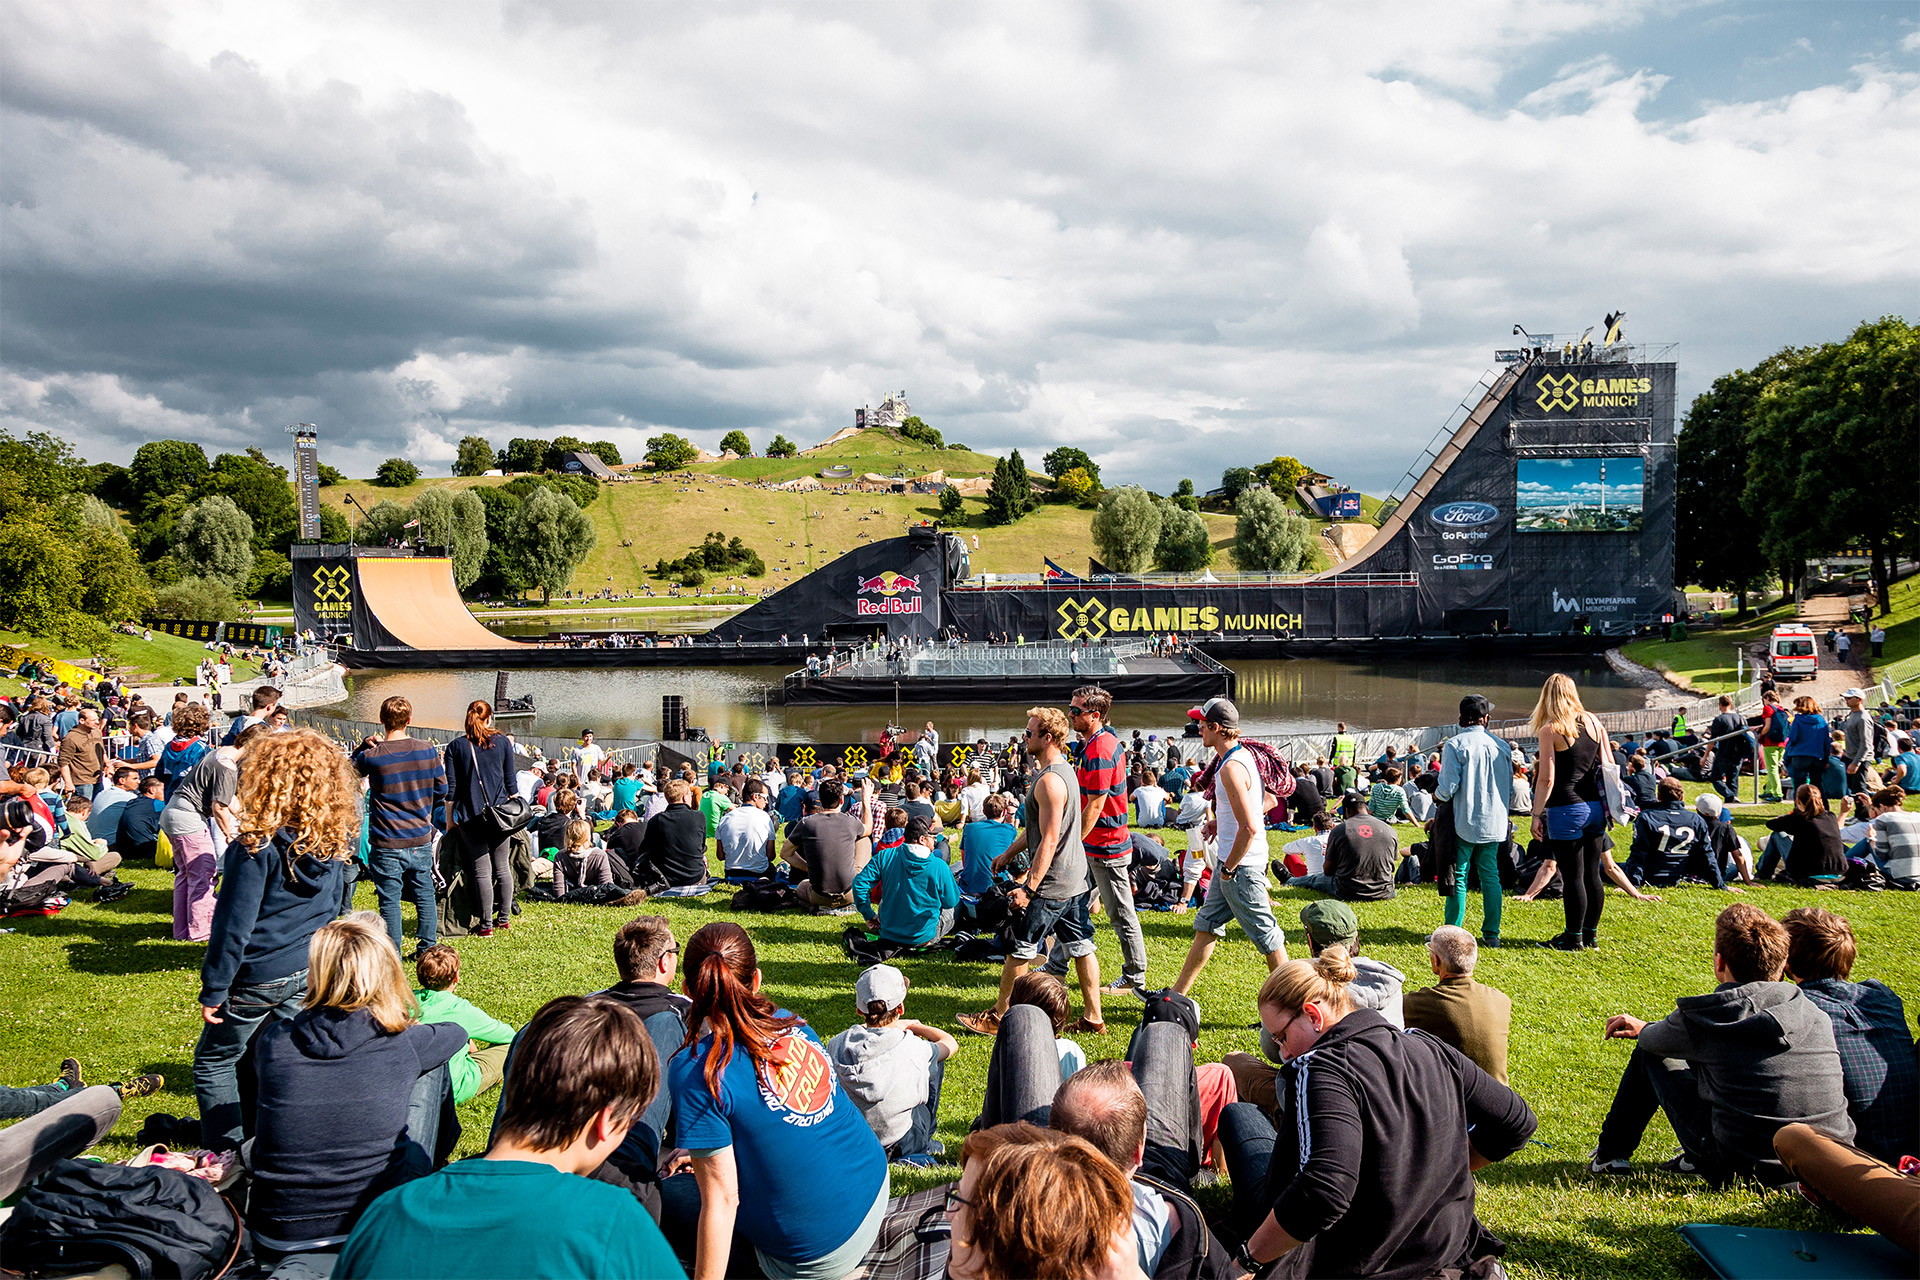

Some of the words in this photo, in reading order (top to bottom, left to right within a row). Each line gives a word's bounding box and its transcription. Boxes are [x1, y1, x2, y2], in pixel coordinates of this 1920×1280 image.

[1581, 377, 1652, 395] GAMES
[1582, 395, 1638, 408] MUNICH
[1443, 505, 1486, 522] Ford
[1442, 531, 1455, 540] Go
[1456, 530, 1488, 539] Further
[1432, 553, 1494, 564] GoPro
[313, 602, 352, 612] GAMES
[857, 596, 890, 615] Red
[890, 595, 922, 615] Bull
[1585, 597, 1637, 605] OLYMPIAPARK
[318, 611, 349, 619] MUNICH
[1108, 606, 1219, 632] GAMES
[1224, 613, 1303, 631] MUNICH
[1657, 824, 1695, 855] 12
[775, 1035, 809, 1106] SANTA
[794, 1051, 825, 1115] CRUZ
[782, 1112, 814, 1127] CRUZ
